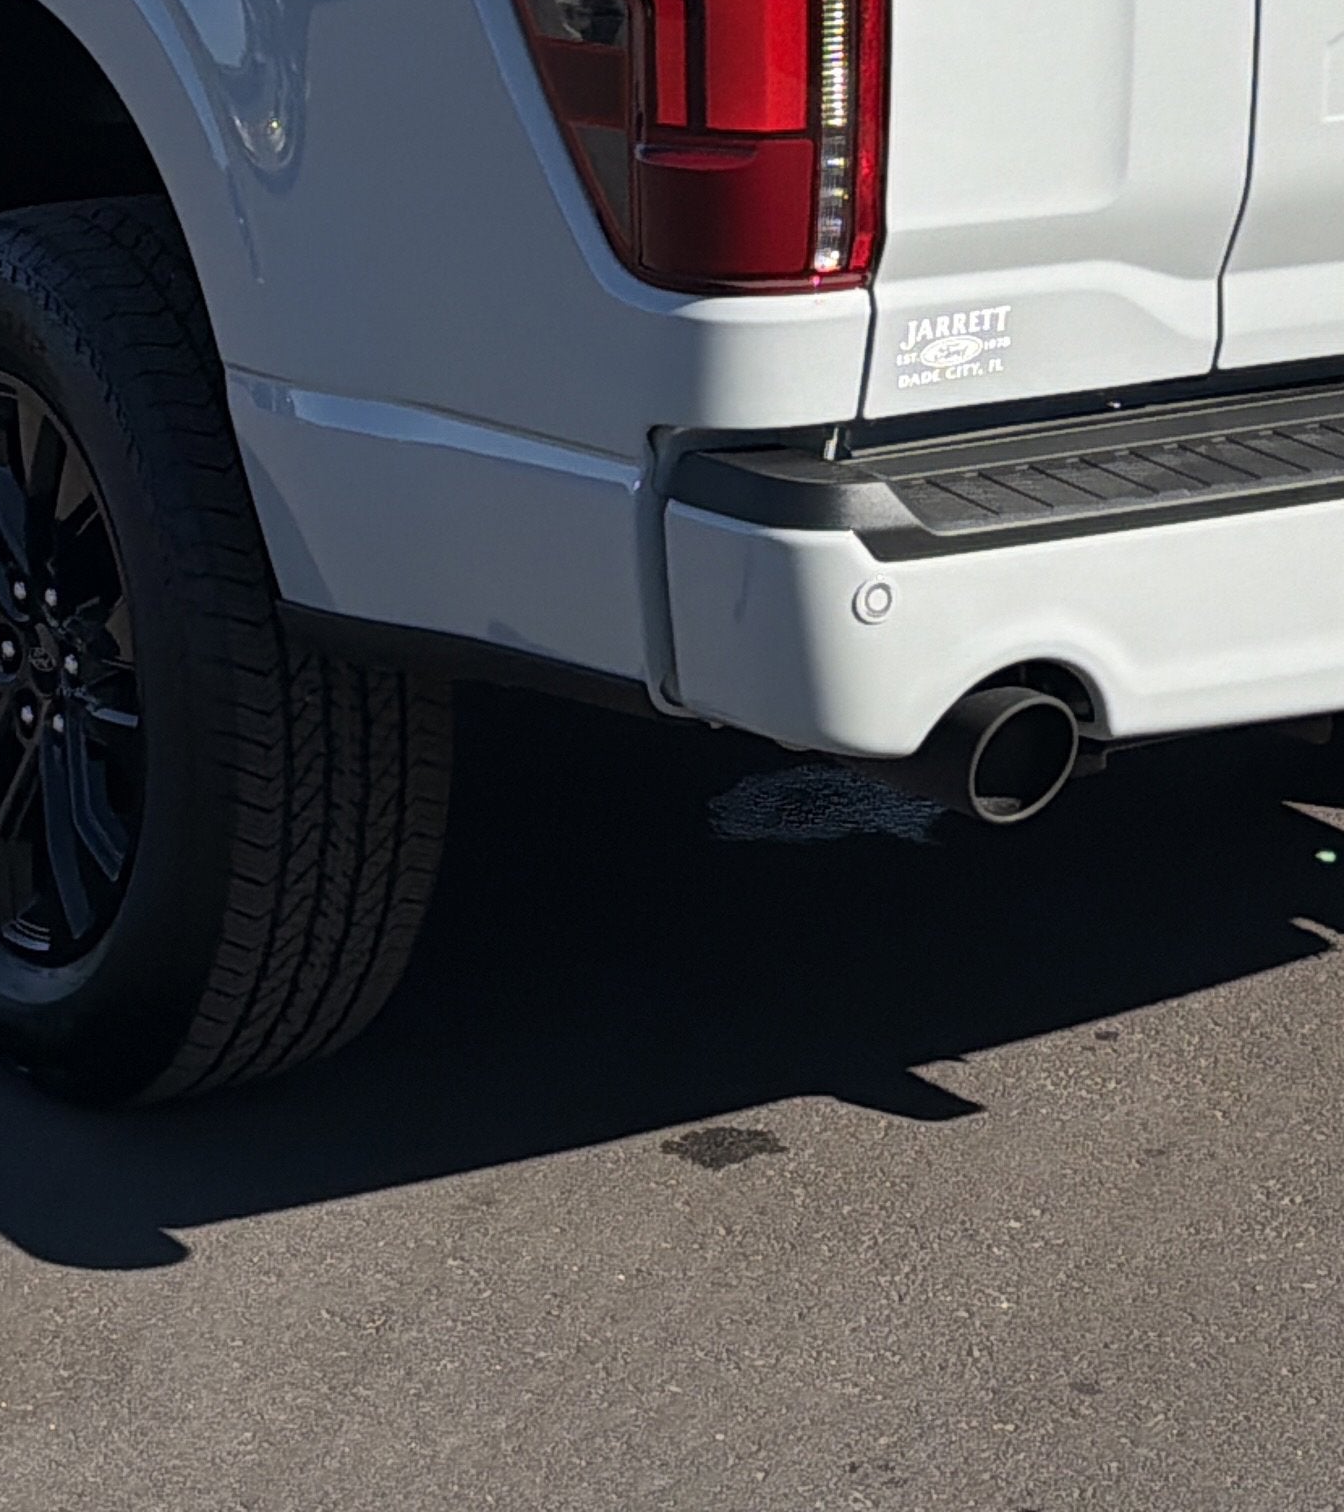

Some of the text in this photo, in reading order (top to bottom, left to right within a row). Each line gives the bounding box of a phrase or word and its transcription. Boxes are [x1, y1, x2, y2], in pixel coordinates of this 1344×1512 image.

[899, 305, 1012, 351] JARRETT
[897, 368, 941, 389] DADE
[988, 358, 1004, 373] FL
